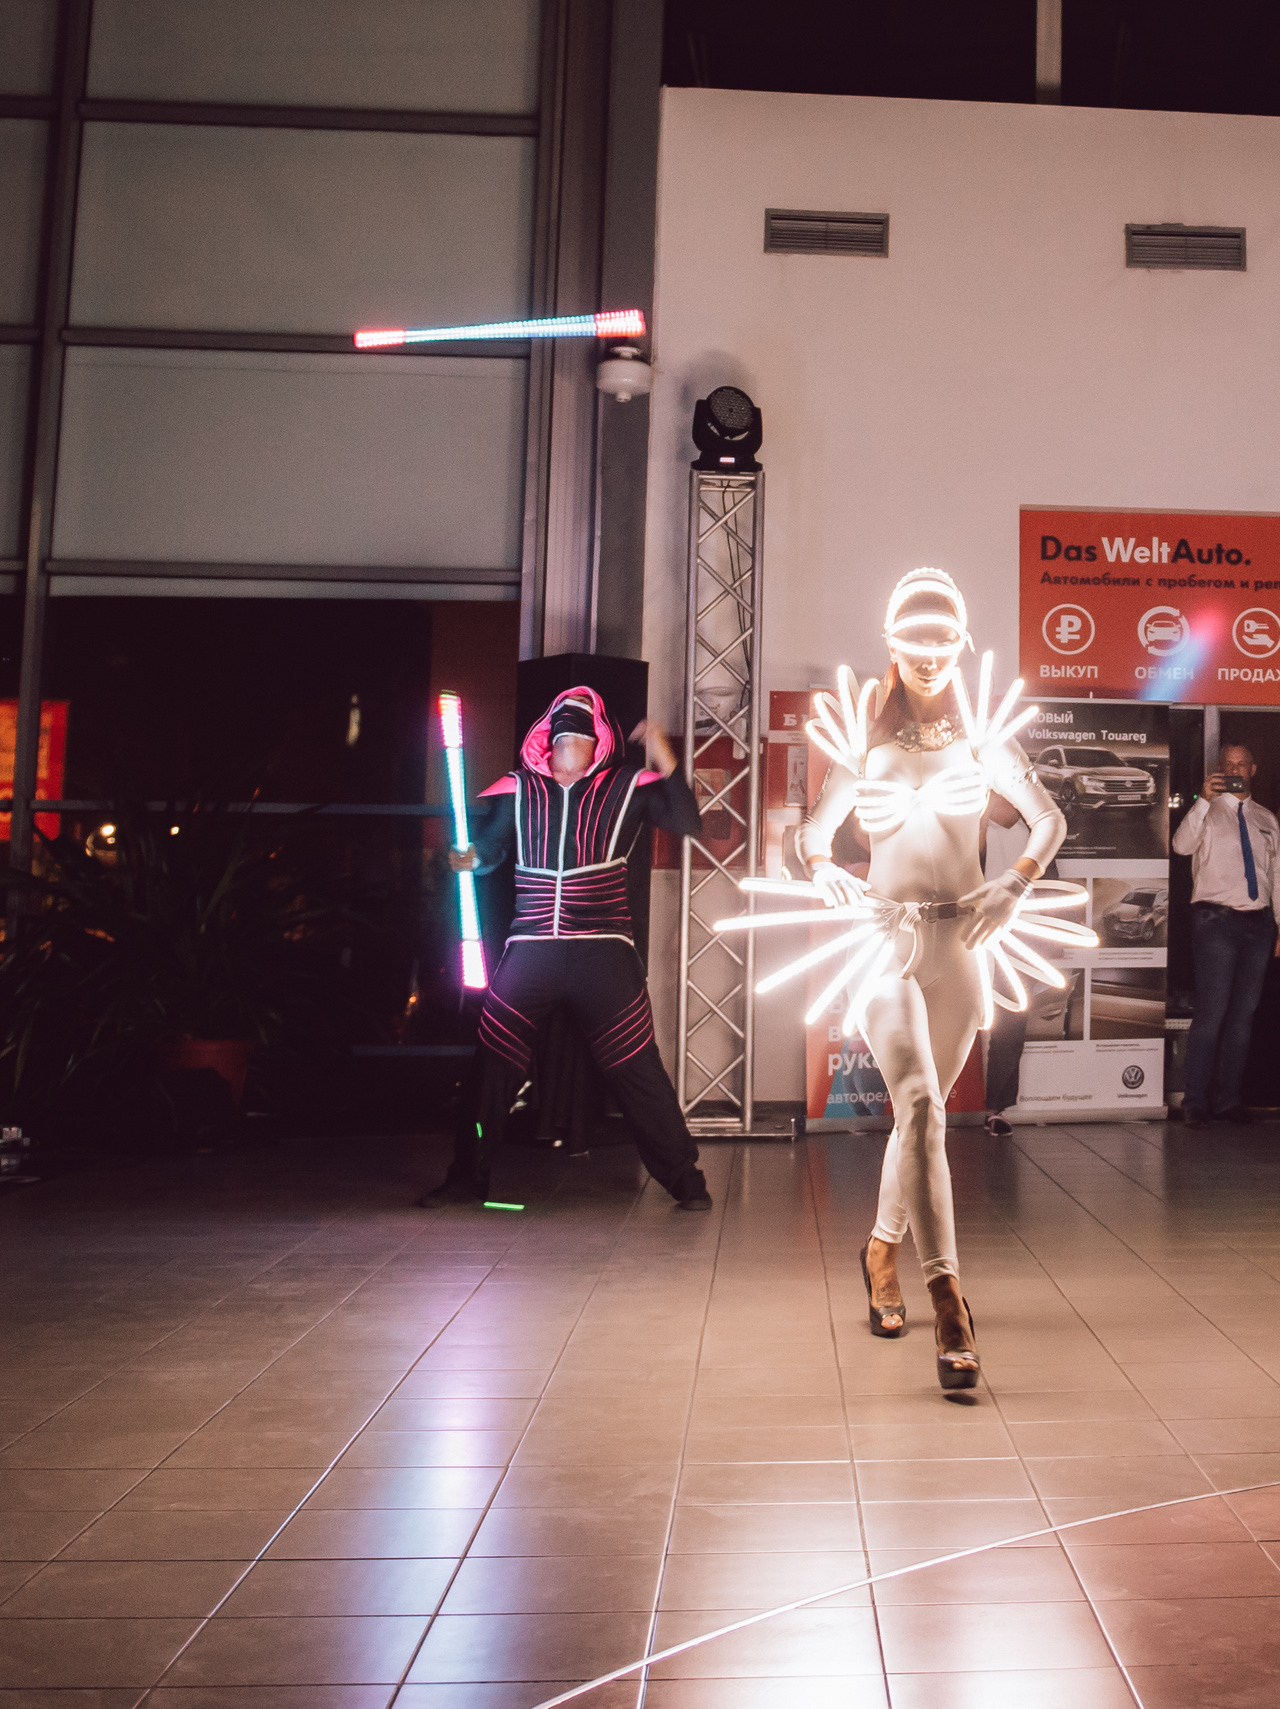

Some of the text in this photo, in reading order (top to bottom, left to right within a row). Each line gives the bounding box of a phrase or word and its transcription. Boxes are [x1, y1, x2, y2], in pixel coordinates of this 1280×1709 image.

[1040, 535, 1098, 562] Das
[1041, 571, 1141, 587] Автомобили
[1145, 577, 1153, 587] с
[1157, 573, 1235, 590] пробегом
[1240, 578, 1250, 588] и
[1039, 664, 1099, 679] ВЫКУП
[1134, 666, 1194, 680] ОБМЕН
[1027, 728, 1147, 744] Volkswagen Touareg
